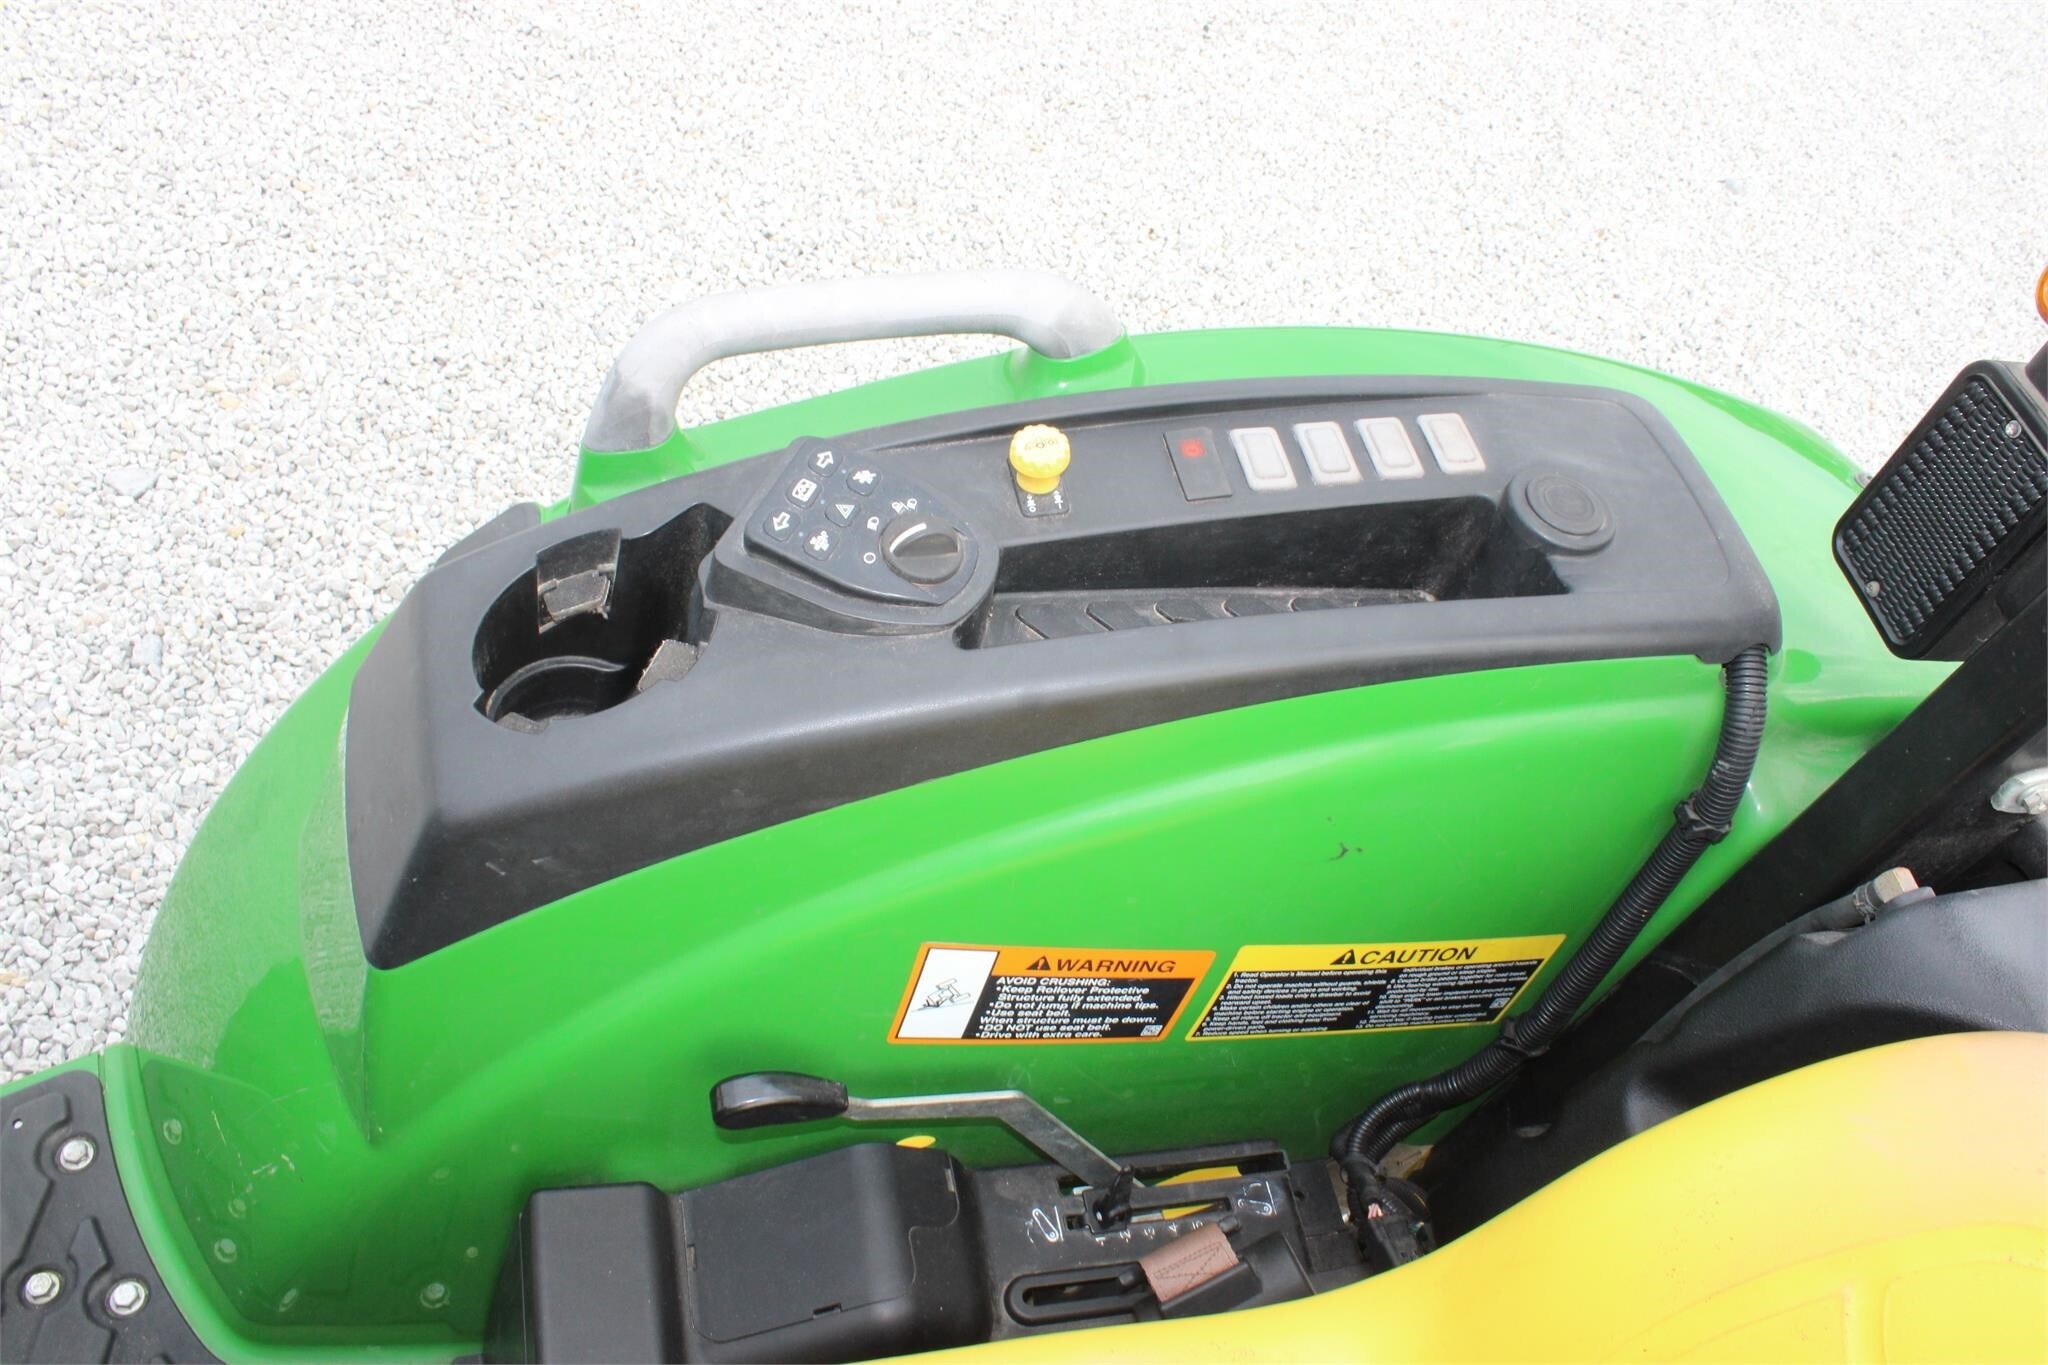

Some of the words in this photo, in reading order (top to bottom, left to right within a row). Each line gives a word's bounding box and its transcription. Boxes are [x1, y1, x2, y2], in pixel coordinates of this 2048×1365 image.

[1359, 946, 1478, 965] CAUTION
[1056, 959, 1176, 973] WARNING
[996, 977, 1037, 985] AVOID
[1040, 978, 1111, 986] CRUSHING:
[997, 993, 1055, 1001] Structure
[1057, 994, 1084, 1003] fully
